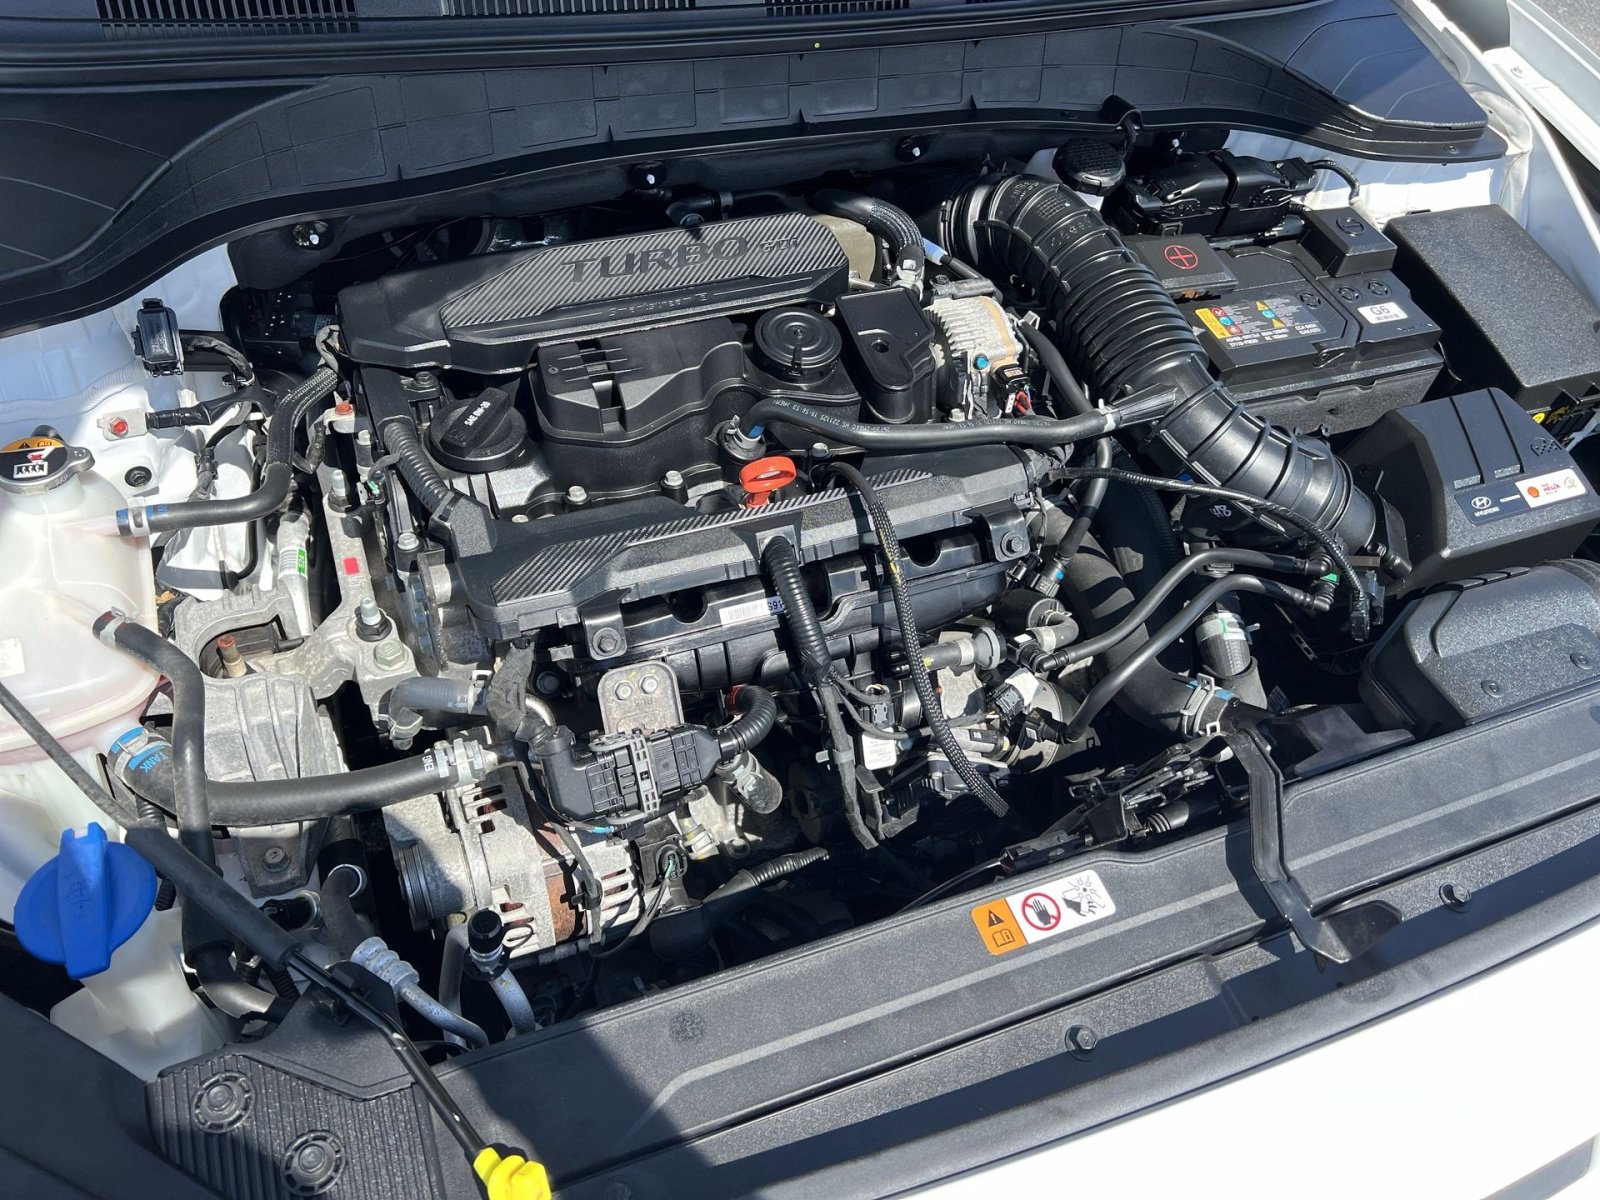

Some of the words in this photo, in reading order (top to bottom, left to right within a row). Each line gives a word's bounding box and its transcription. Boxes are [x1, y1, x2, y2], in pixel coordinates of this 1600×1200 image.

[562, 236, 749, 283] TURBO
[1369, 305, 1390, 316] G6
[1474, 507, 1500, 517] HYUNDAI
[140, 751, 169, 773] TANK
[422, 754, 434, 772] ENG
